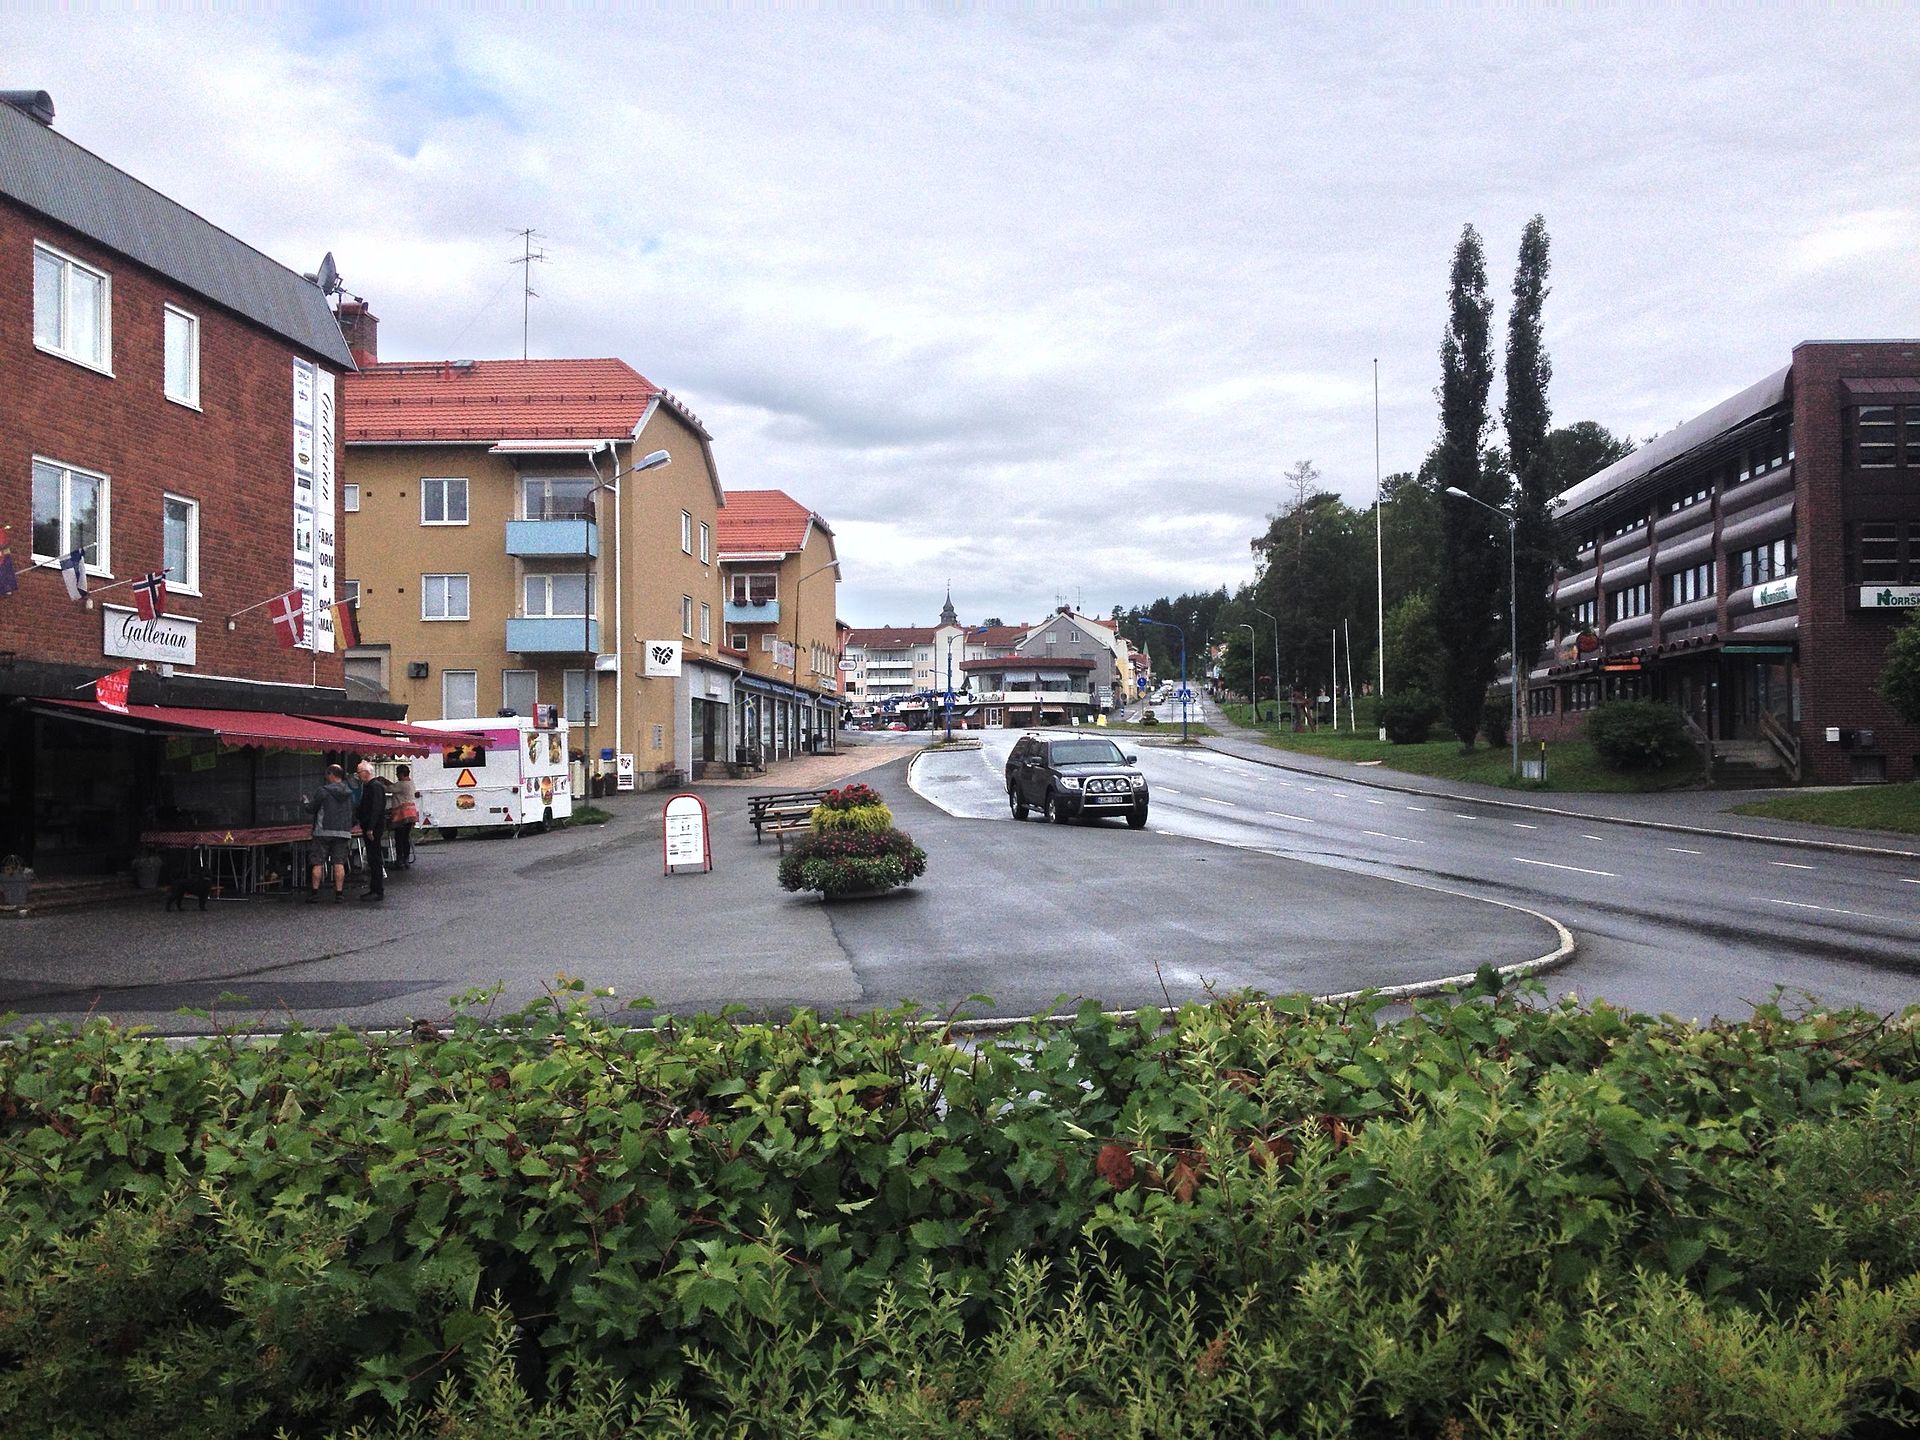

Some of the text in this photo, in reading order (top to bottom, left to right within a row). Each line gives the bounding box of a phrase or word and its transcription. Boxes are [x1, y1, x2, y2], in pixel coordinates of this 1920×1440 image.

[319, 386, 334, 501] Gallerian
[319, 552, 333, 568] ORM
[322, 575, 328, 588] &
[115, 614, 188, 651] Gallerian
